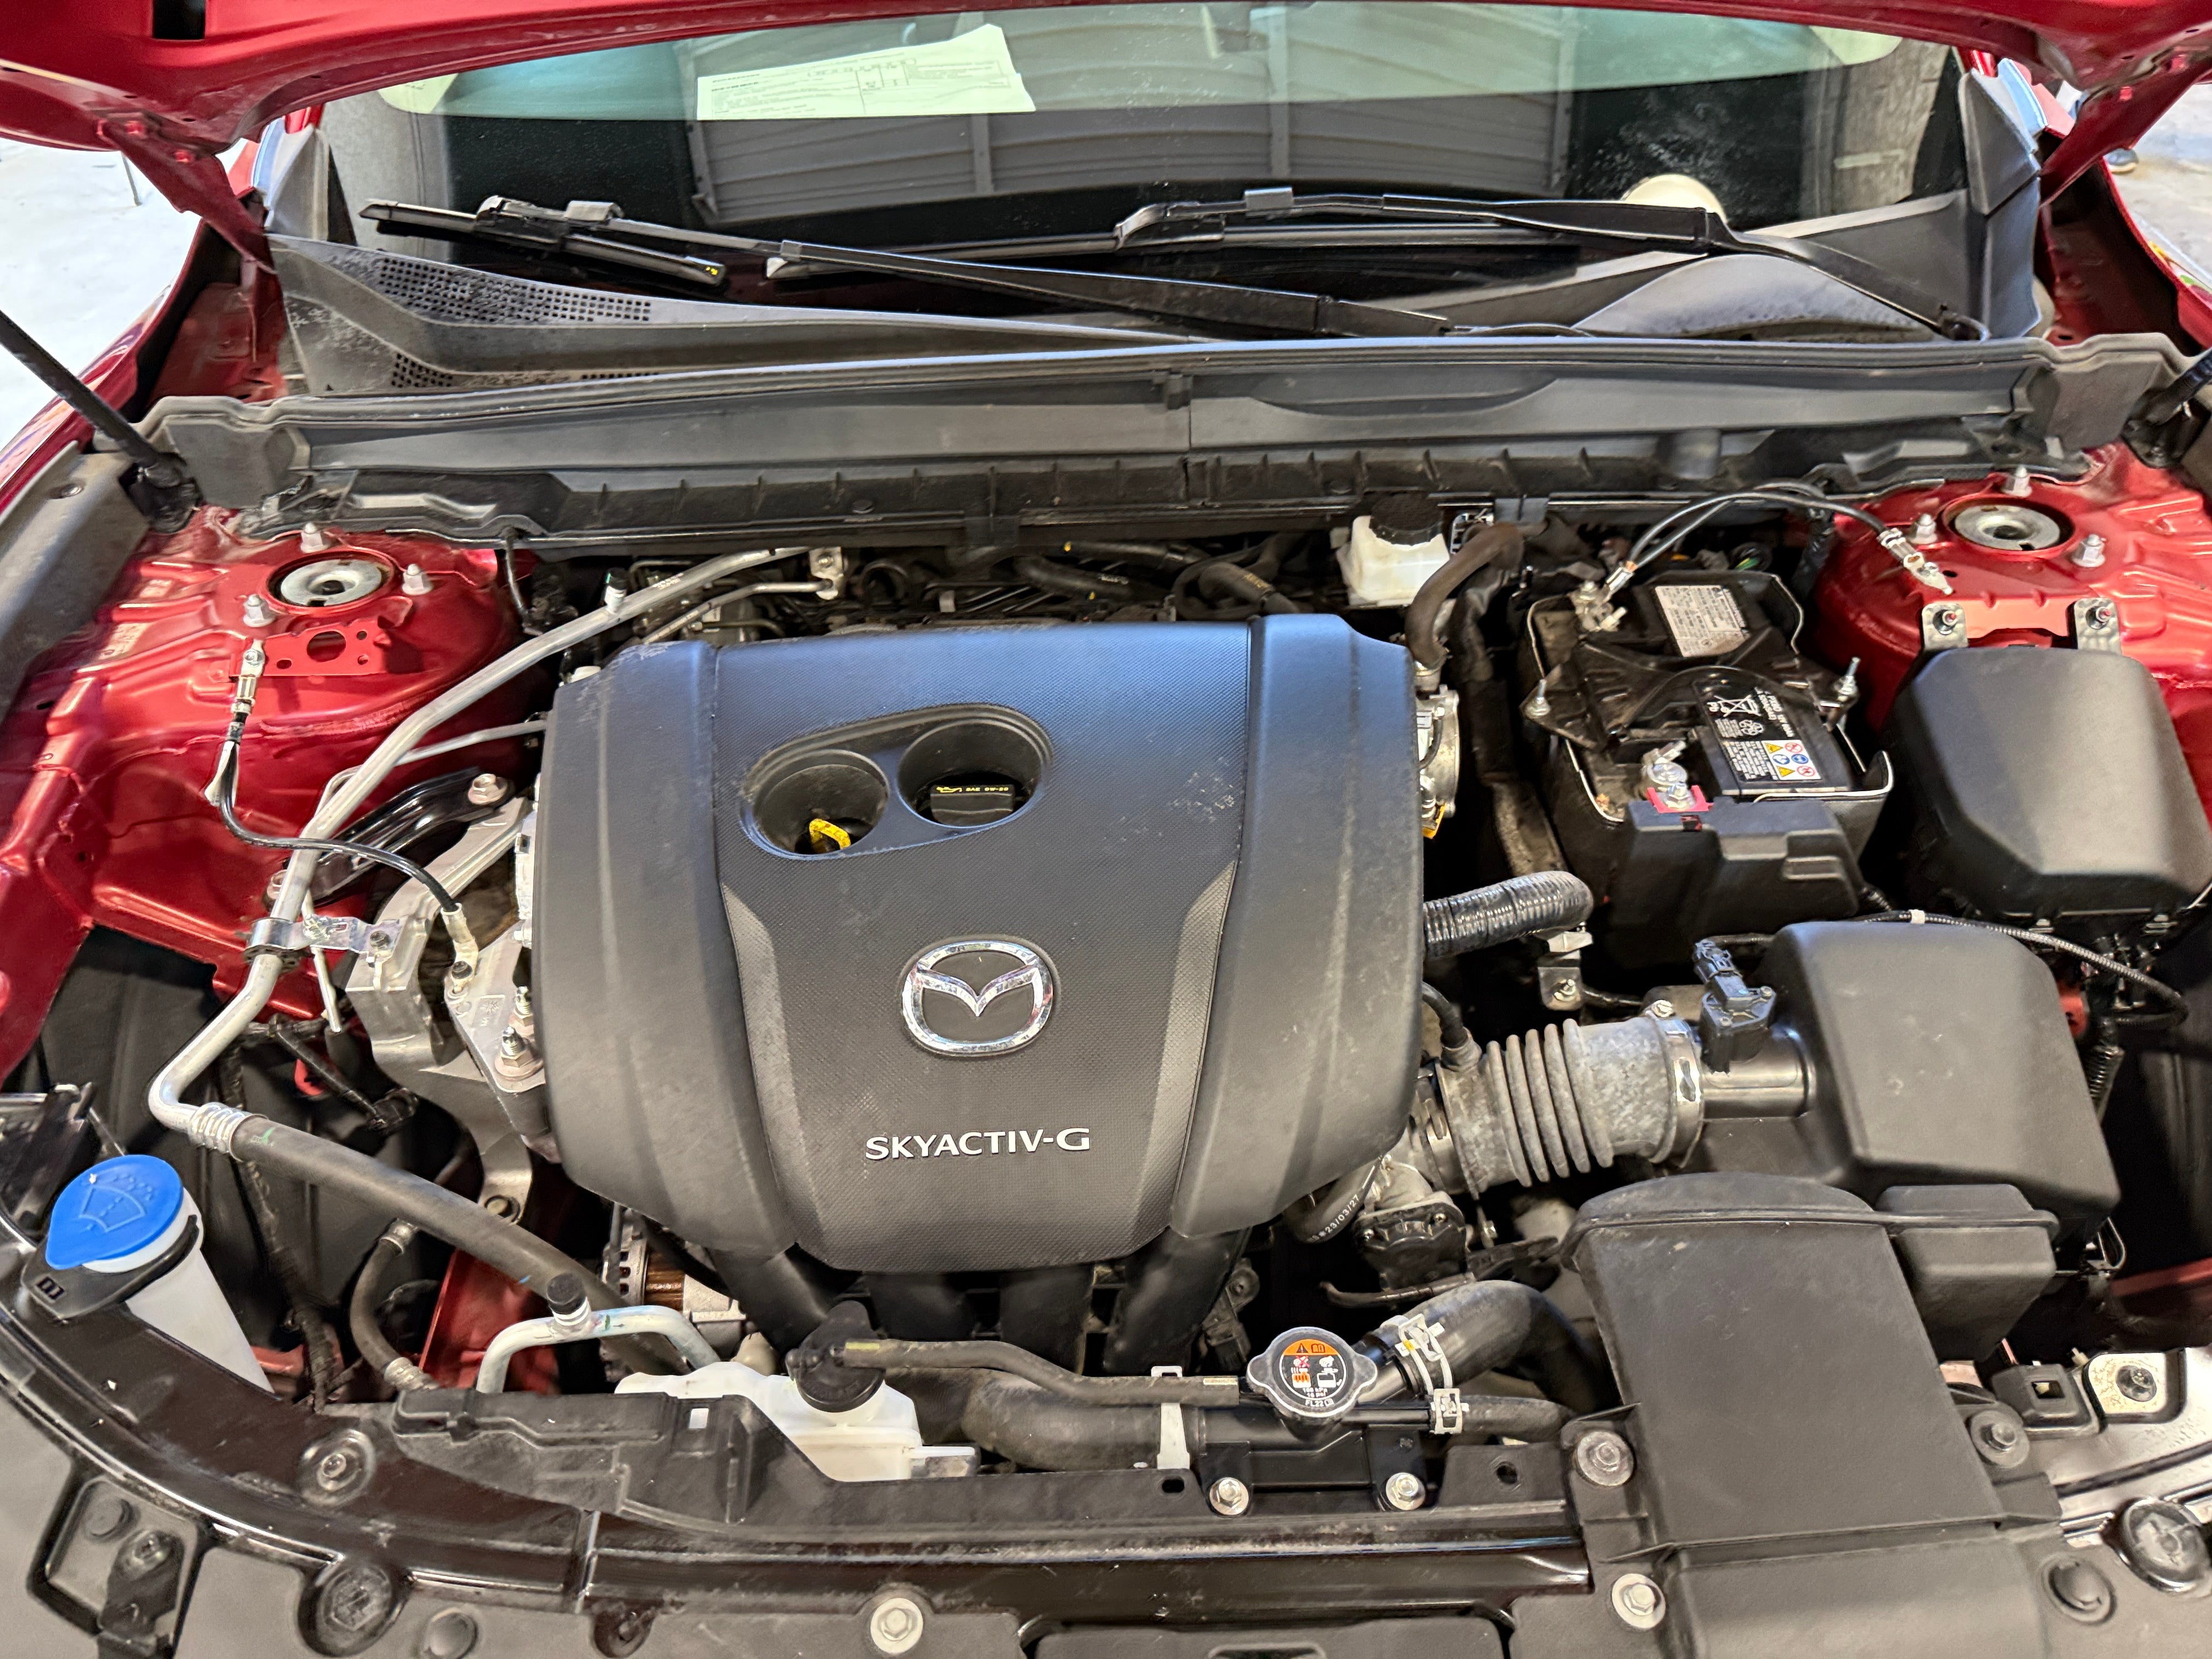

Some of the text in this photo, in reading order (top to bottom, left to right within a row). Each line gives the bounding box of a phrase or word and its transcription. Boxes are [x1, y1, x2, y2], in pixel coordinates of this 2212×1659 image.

[1707, 702, 1720, 712] Pb
[865, 1127, 1090, 1160] SKYACTIV-G
[1325, 1194, 1359, 1233] 23/03/27
[1305, 1399, 1324, 1407] FL22
